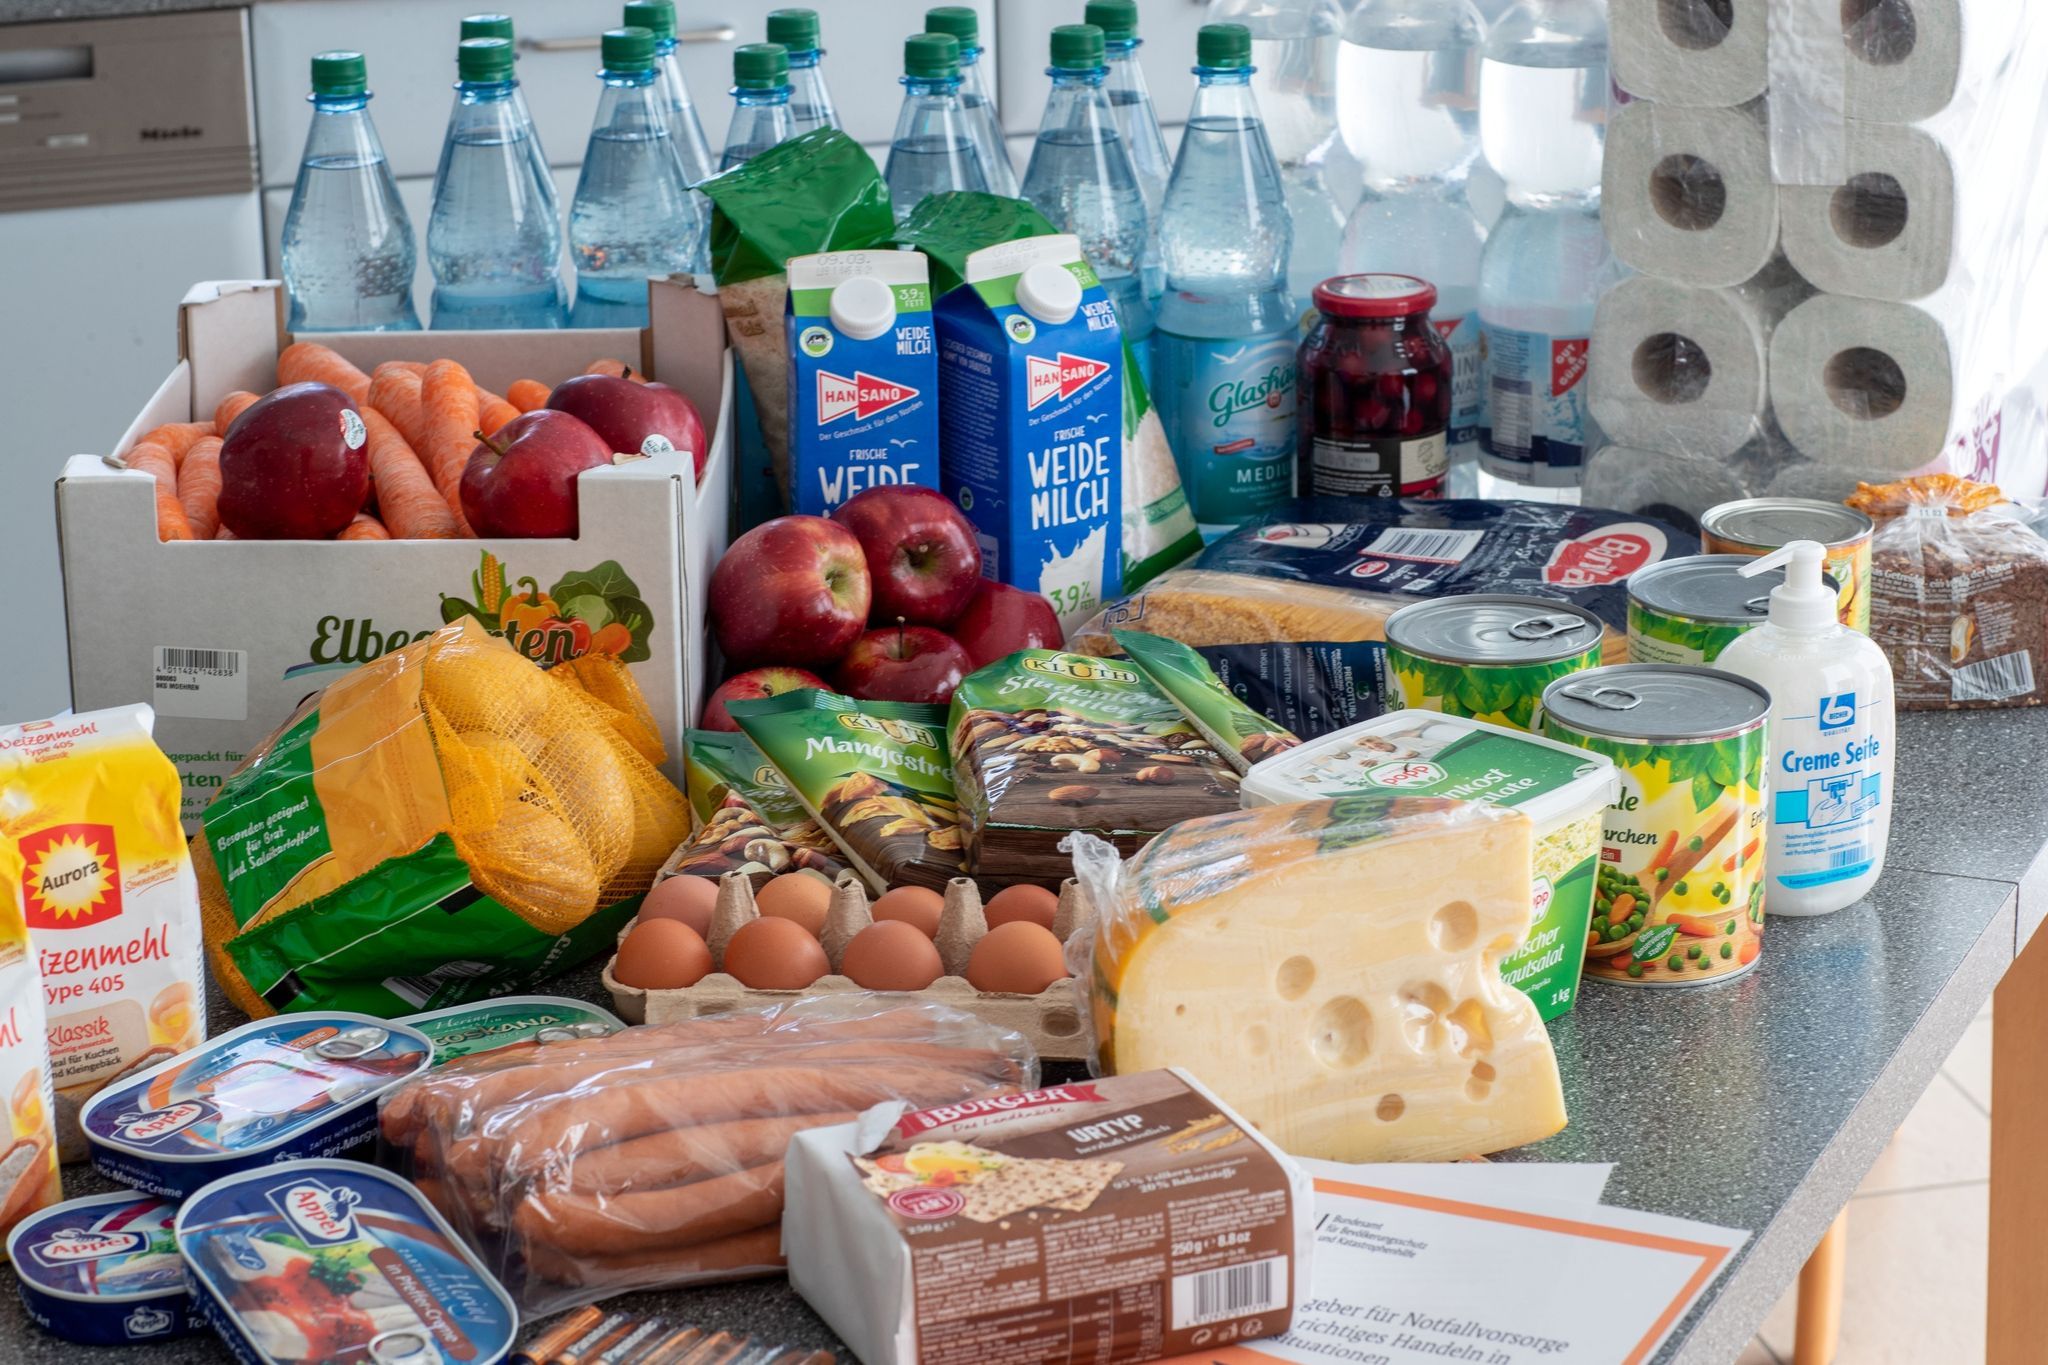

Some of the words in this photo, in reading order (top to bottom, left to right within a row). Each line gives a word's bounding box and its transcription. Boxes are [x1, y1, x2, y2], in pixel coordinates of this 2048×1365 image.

[1080, 300, 1114, 317] WEIDE
[1086, 314, 1117, 332] MILCH
[895, 326, 931, 340] WEIDE
[896, 340, 931, 355] MILCH
[818, 432, 832, 441] Der
[833, 423, 873, 439] Geschmack
[873, 418, 884, 428] für
[885, 413, 899, 424] den
[898, 400, 925, 417] Norden
[1028, 417, 1040, 427] Der
[1040, 403, 1074, 423] Geschmack
[1054, 425, 1086, 442] FRISCHE
[849, 449, 888, 460] FRISCHE
[1027, 437, 1110, 488] WEIDE
[1031, 476, 1109, 530] MILCH
[1033, 660, 1132, 684] KLUTH
[225, 751, 246, 762] für
[805, 736, 955, 783] Mangostre
[1782, 752, 1841, 773] Creme
[1845, 735, 1881, 764] Seife
[1437, 768, 1513, 800] inkost
[1482, 776, 1540, 806] alate
[40, 860, 100, 894] Aurora
[39, 923, 170, 977] izenmehl
[88, 974, 125, 994] 405
[47, 1015, 112, 1047] Klassik
[51, 1067, 65, 1080] nd
[65, 1055, 122, 1077] Kleingebäck
[68, 1053, 84, 1065] für
[84, 1045, 120, 1061] Kuchen
[933, 1083, 1079, 1123] BURGER
[135, 1105, 196, 1137] Appel
[1067, 1112, 1144, 1143] URTYP
[293, 1189, 346, 1237] Appel
[1332, 1213, 1385, 1231] Bundesamt
[51, 1236, 132, 1256] Appel
[1316, 1232, 1337, 1247] und
[1337, 1236, 1418, 1260] Katastrophenhilfe
[1325, 1222, 1339, 1235] für
[1339, 1224, 1428, 1252] Bevölkerungsschutz
[385, 1261, 402, 1279] in
[1296, 1317, 1389, 1346] richtiges
[1396, 1331, 1486, 1363] Handeln
[1490, 1350, 1512, 1365] in
[1363, 1301, 1401, 1326] für
[1406, 1311, 1570, 1355] Notfallvorsorge
